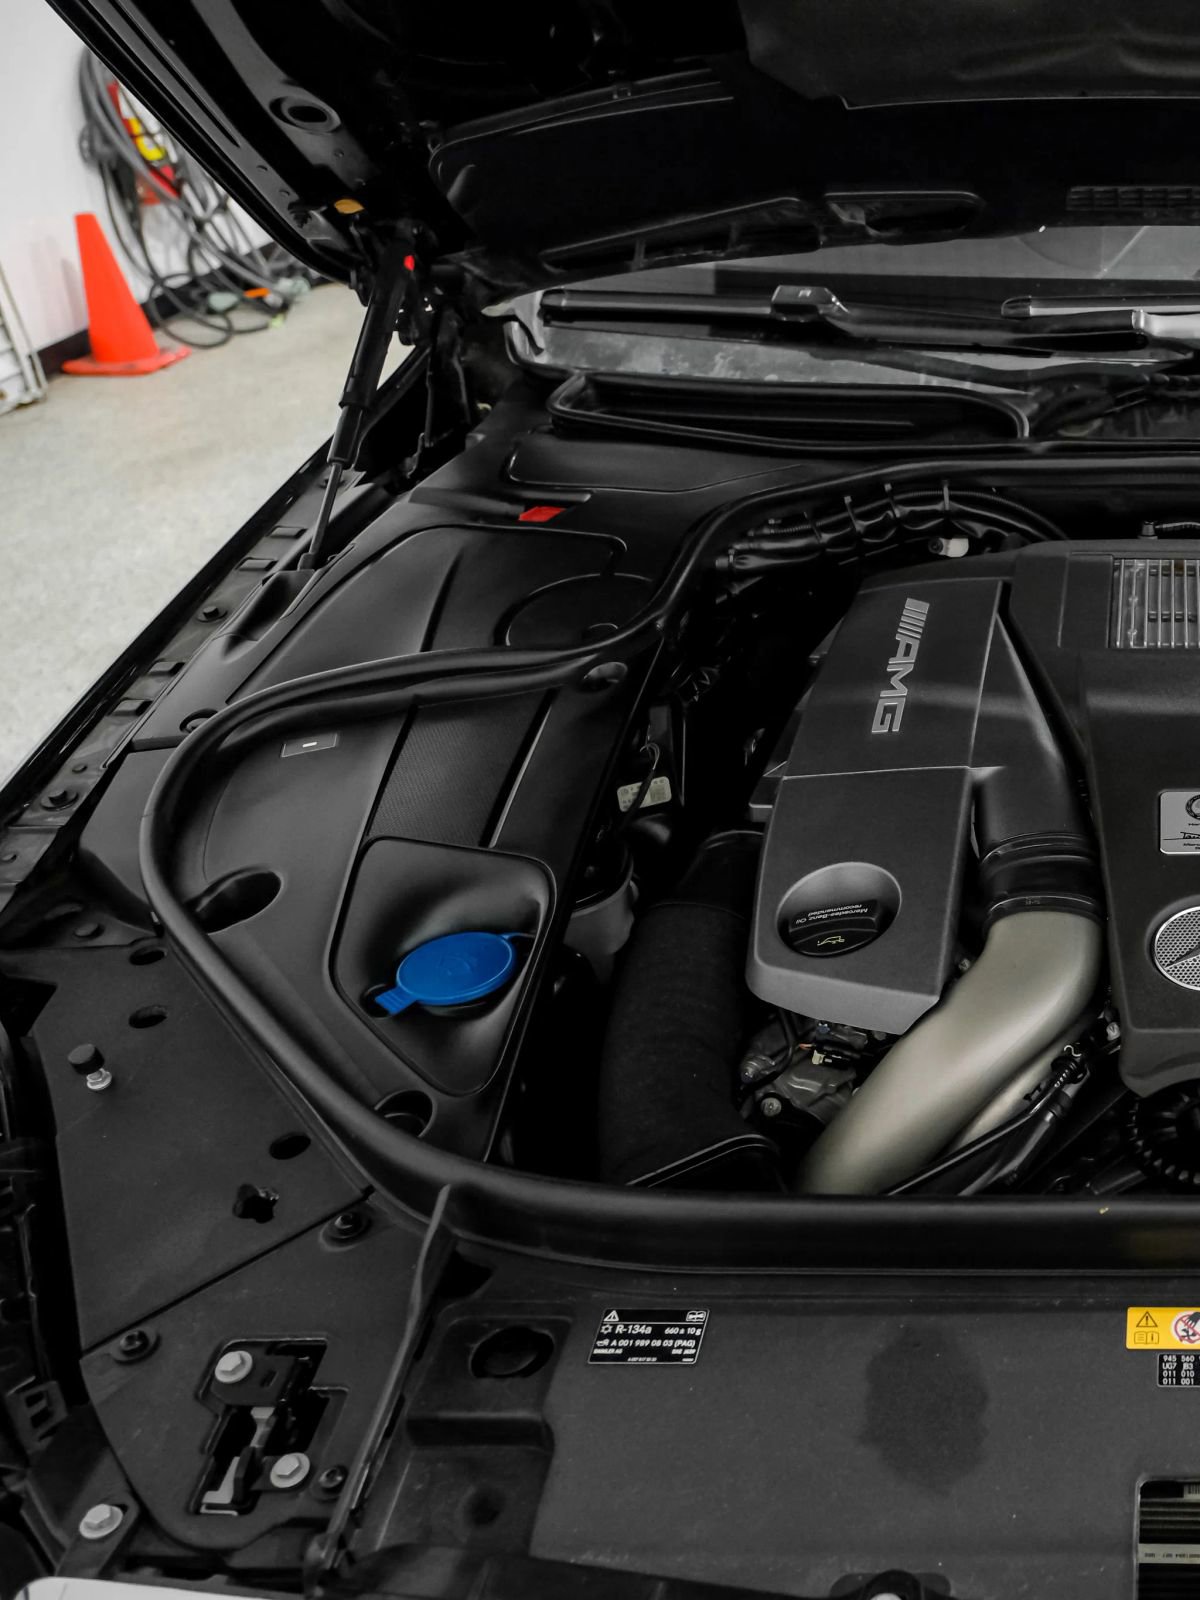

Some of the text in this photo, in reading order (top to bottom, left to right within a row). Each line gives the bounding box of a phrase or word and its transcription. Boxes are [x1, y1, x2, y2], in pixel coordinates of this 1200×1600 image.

[870, 632, 922, 734] AMG
[808, 904, 862, 917] recommended
[808, 908, 868, 921] Mercedes-Benz
[615, 1325, 653, 1335] R-134a
[664, 1327, 680, 1335] 660
[687, 1327, 696, 1335] 10
[695, 1328, 702, 1336] g
[610, 1339, 617, 1347] A
[674, 1339, 696, 1348] (PAG)
[1162, 1362, 1177, 1370] UG7
[1162, 1370, 1176, 1378] 011
[1181, 1370, 1195, 1378] 010
